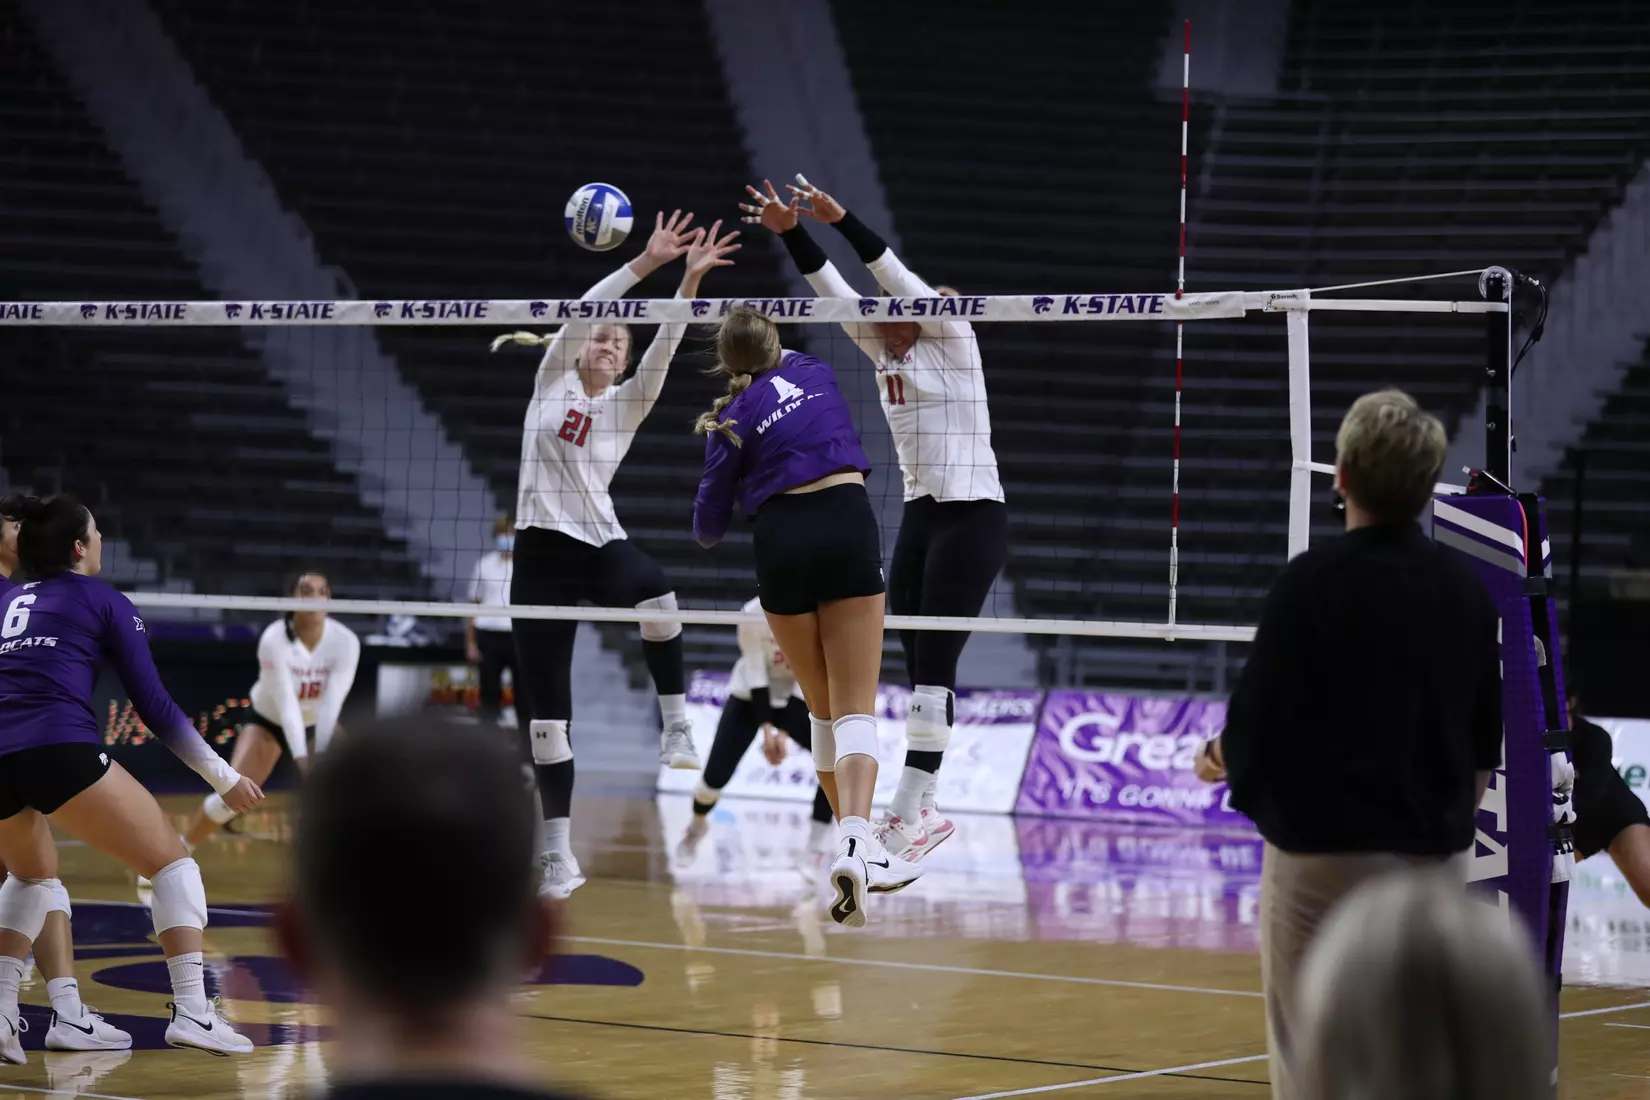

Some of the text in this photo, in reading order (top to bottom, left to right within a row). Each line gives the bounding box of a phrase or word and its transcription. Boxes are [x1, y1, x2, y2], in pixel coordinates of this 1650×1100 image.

[105, 303, 188, 320] K-STATE
[249, 303, 336, 320] K-STATE
[400, 302, 489, 319] K-STATE
[556, 300, 649, 318] K-STATE
[887, 297, 987, 316] K-STATE
[1062, 295, 1165, 315] K-STATE
[769, 375, 805, 404] 4
[886, 374, 906, 406] 11
[557, 409, 593, 448] 21
[1, 593, 37, 639] 6
